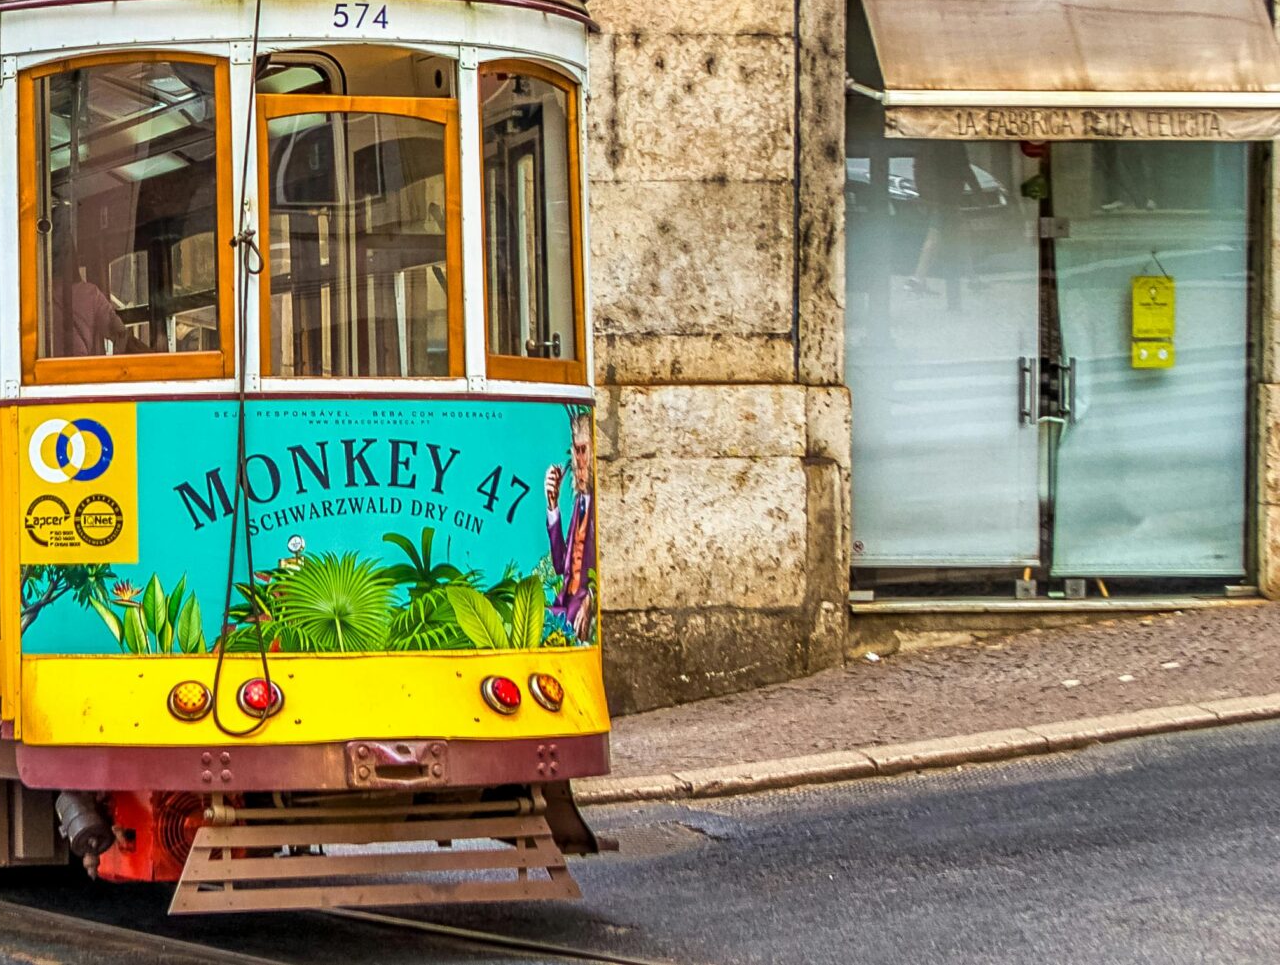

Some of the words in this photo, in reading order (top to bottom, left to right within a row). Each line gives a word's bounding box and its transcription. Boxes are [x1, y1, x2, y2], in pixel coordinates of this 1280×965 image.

[333, 3, 389, 29] 574
[956, 110, 978, 136] LA
[173, 438, 460, 530] MONKEY
[476, 464, 531, 524] 47
[83, 515, 113, 525] IQNet
[248, 496, 403, 536] SCHWARZWALD
[411, 499, 449, 519] DRY
[453, 509, 484, 535] GIN
